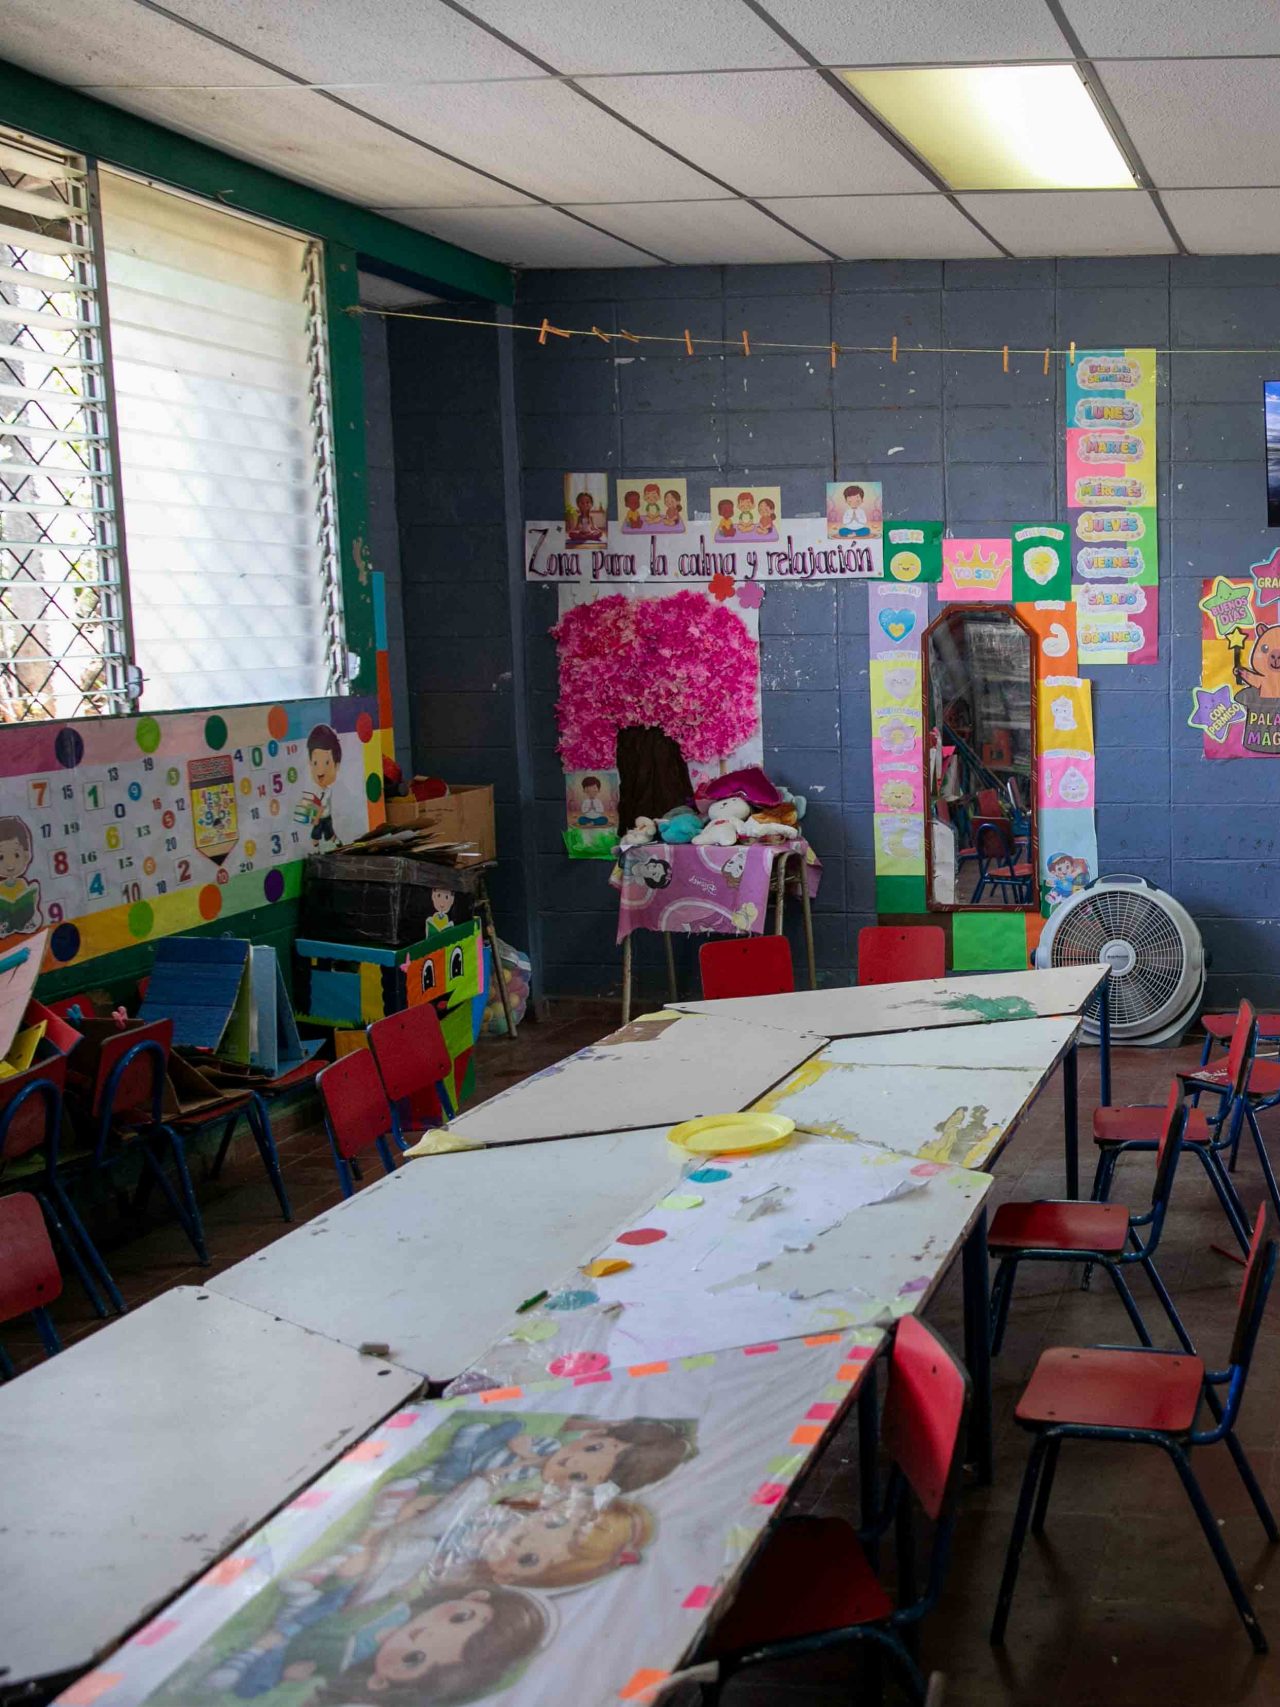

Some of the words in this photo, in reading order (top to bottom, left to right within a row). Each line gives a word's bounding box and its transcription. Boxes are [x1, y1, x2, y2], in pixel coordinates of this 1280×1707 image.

[1084, 405, 1134, 420] LUNES
[1087, 441, 1137, 454] MARTES
[1084, 518, 1138, 532] JUEVES
[528, 528, 582, 576] Zona
[651, 535, 668, 576] la
[678, 535, 736, 576] calma
[744, 551, 759, 579] y
[766, 535, 874, 579] relajación
[1084, 557, 1138, 569] VIERNES
[954, 568, 972, 580] YO
[975, 568, 998, 580] SOY
[1211, 596, 1248, 617] BUENOS
[1220, 607, 1247, 625] DÍAS
[1081, 631, 1140, 644] DOMINGO
[1208, 703, 1240, 735] PERMISO
[1209, 703, 1227, 721] CON
[234, 749, 243, 762] 4
[252, 747, 263, 767] 0
[273, 774, 283, 793] 5
[32, 782, 47, 806] 7
[62, 785, 73, 800] 15
[88, 785, 99, 808] 1
[114, 803, 126, 818] 0
[40, 824, 51, 838] 17
[64, 822, 80, 836] 19
[136, 825, 151, 837] 13
[106, 826, 120, 849] 6
[165, 837, 177, 851] 20
[271, 834, 281, 854] 3
[54, 851, 69, 874] 8
[80, 851, 97, 864] 16
[118, 857, 134, 869] 15
[177, 860, 191, 882] 2
[240, 861, 253, 873] 20
[89, 873, 104, 895] 4
[122, 882, 141, 904] 10
[48, 903, 63, 923] 9
